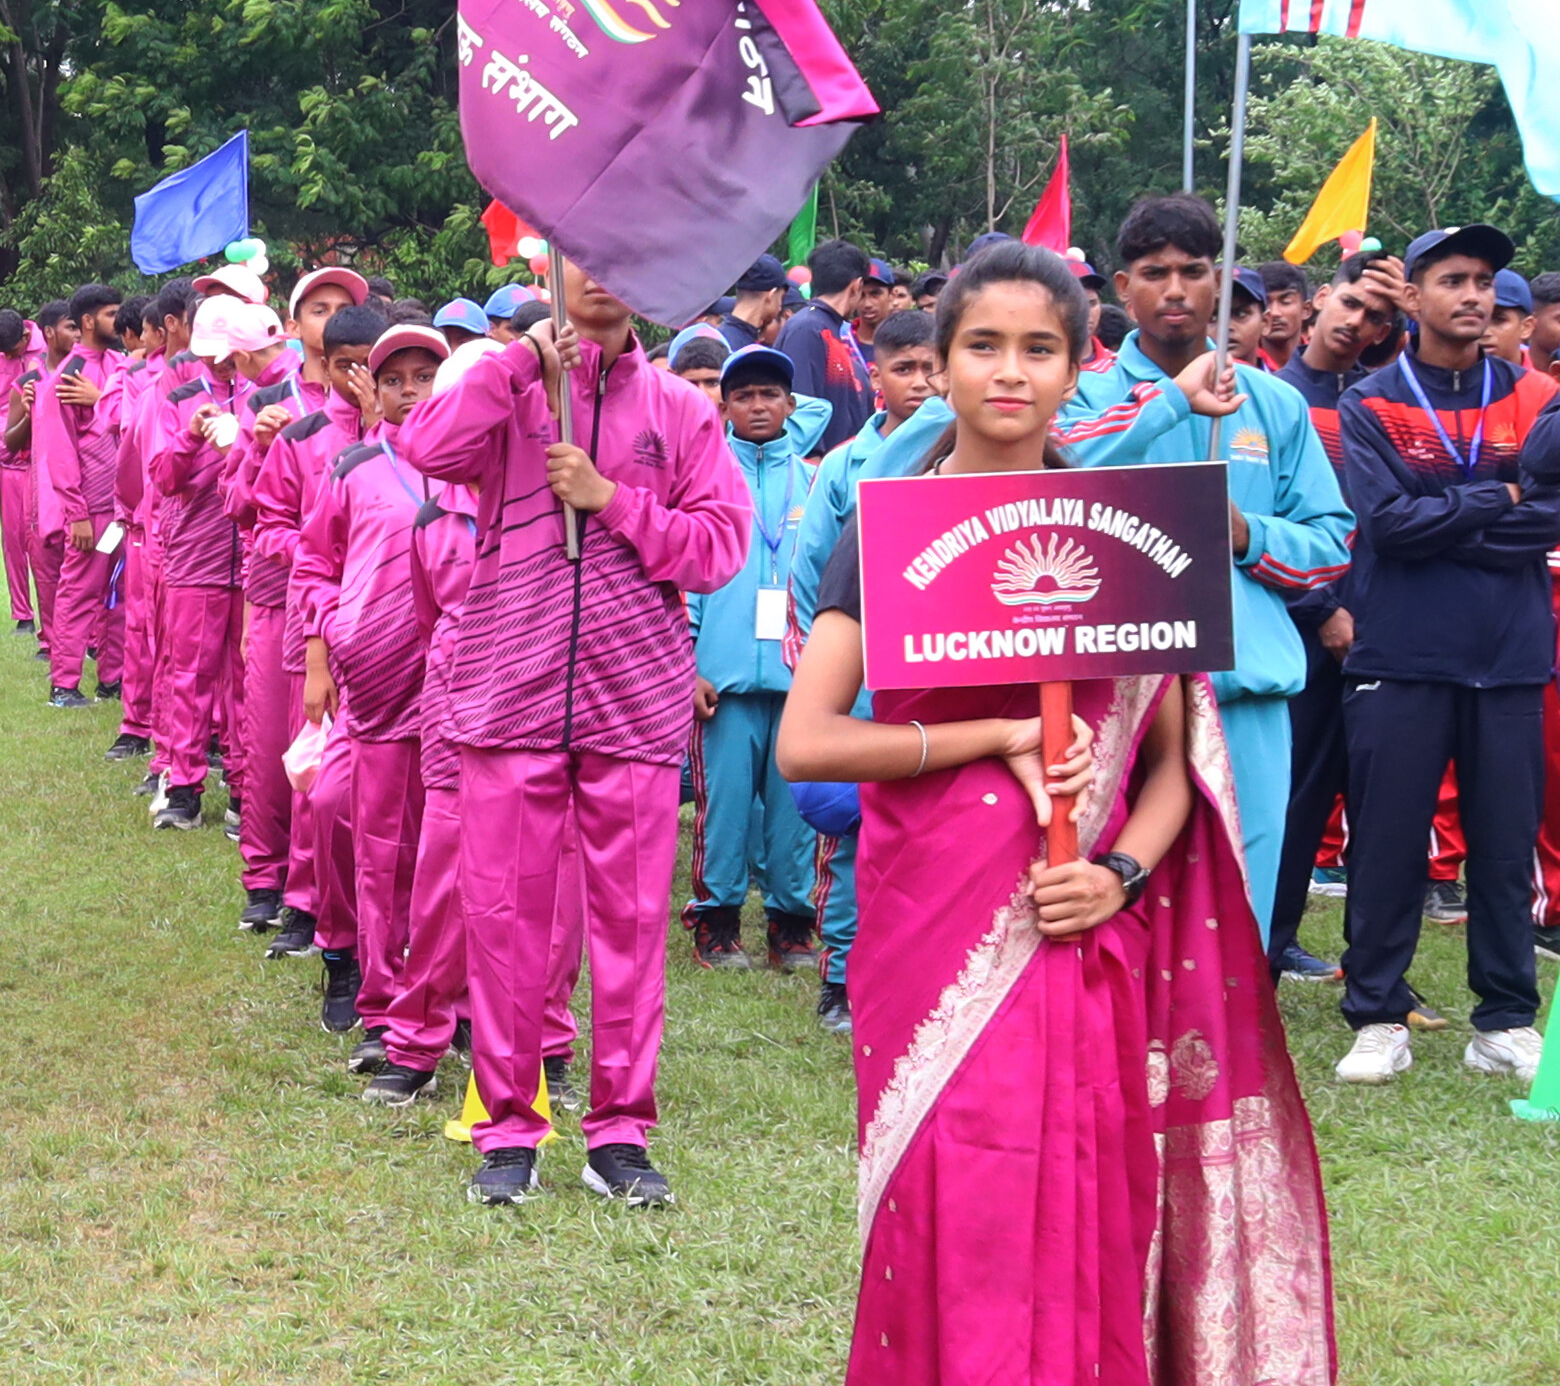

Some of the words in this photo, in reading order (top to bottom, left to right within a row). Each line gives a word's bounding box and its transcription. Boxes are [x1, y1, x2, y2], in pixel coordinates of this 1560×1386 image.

[482, 49, 579, 141] संभाग
[903, 516, 990, 591] KENDRIYA
[984, 497, 1085, 537] VIDYALAYA
[1087, 502, 1193, 579] SANGATHAN
[904, 627, 1067, 663] LUCKNOW
[1075, 620, 1198, 654] REGION
